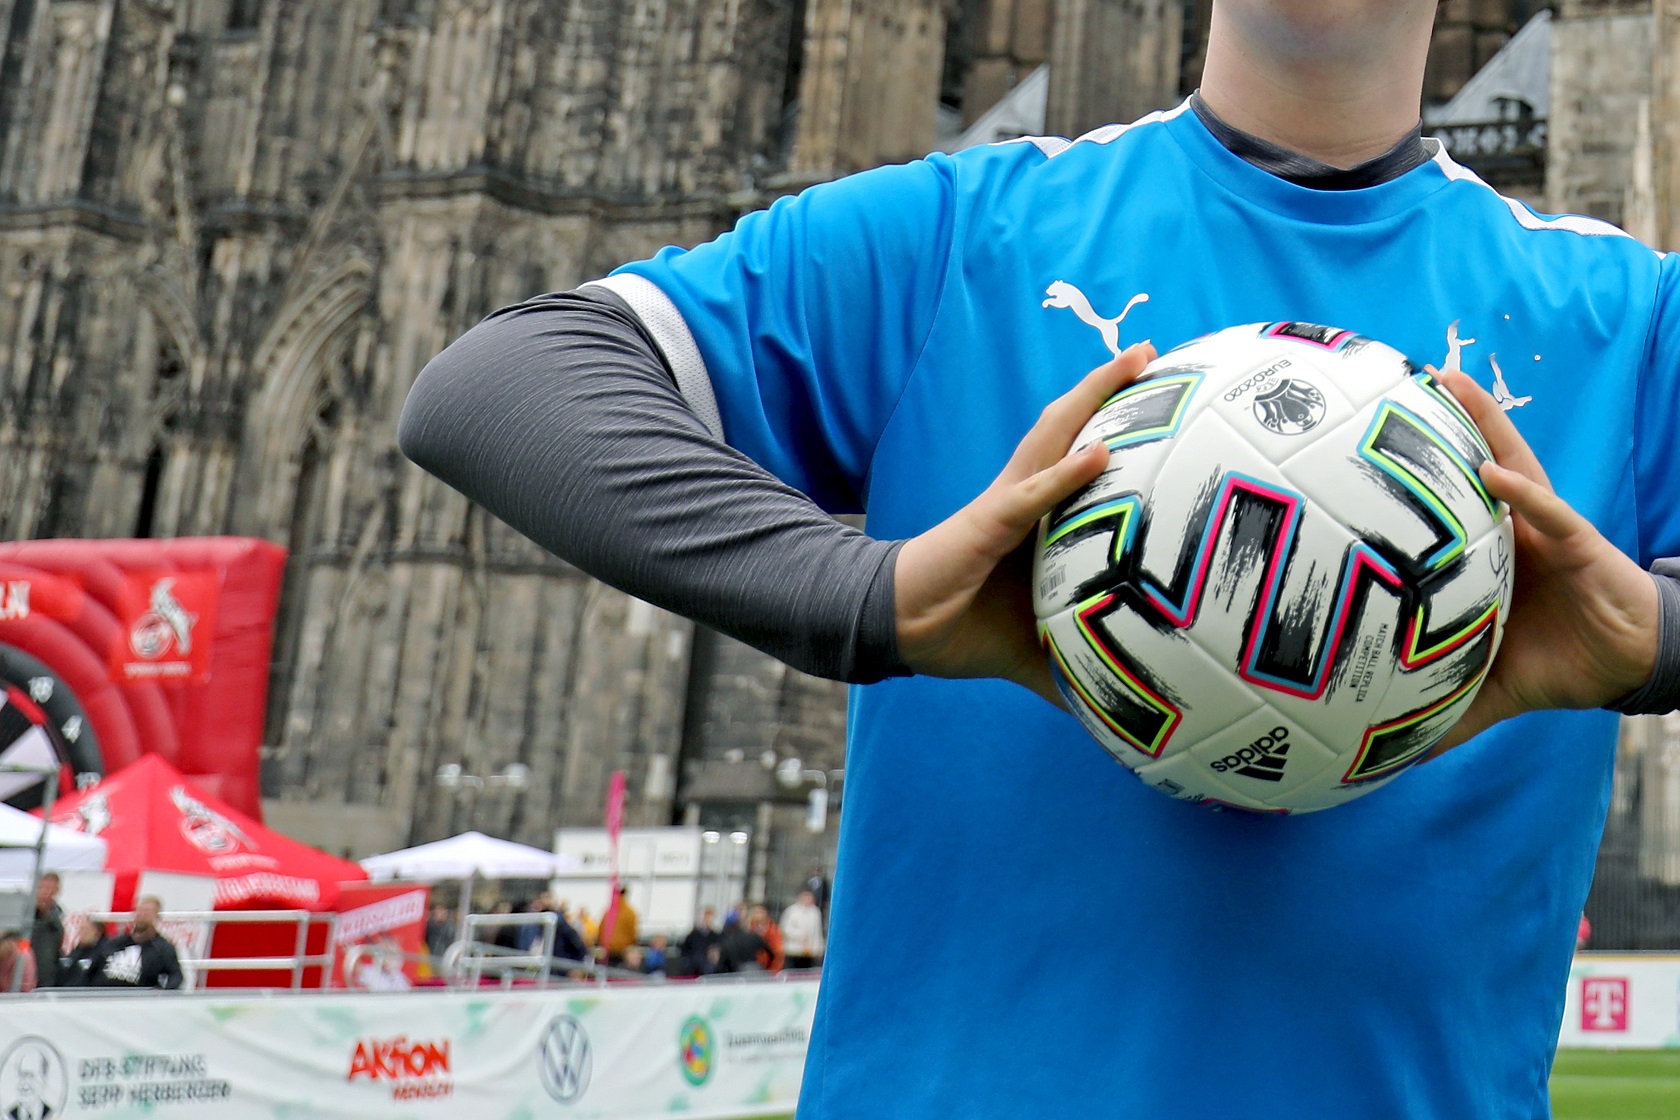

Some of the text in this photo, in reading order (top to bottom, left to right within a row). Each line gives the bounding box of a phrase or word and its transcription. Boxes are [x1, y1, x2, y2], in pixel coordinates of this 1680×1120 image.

[1223, 359, 1292, 402] EURO2020
[1349, 634, 1375, 688] COMPETITION
[1355, 622, 1389, 703] MATCH BALL REPLICA
[1210, 726, 1289, 772] adidas
